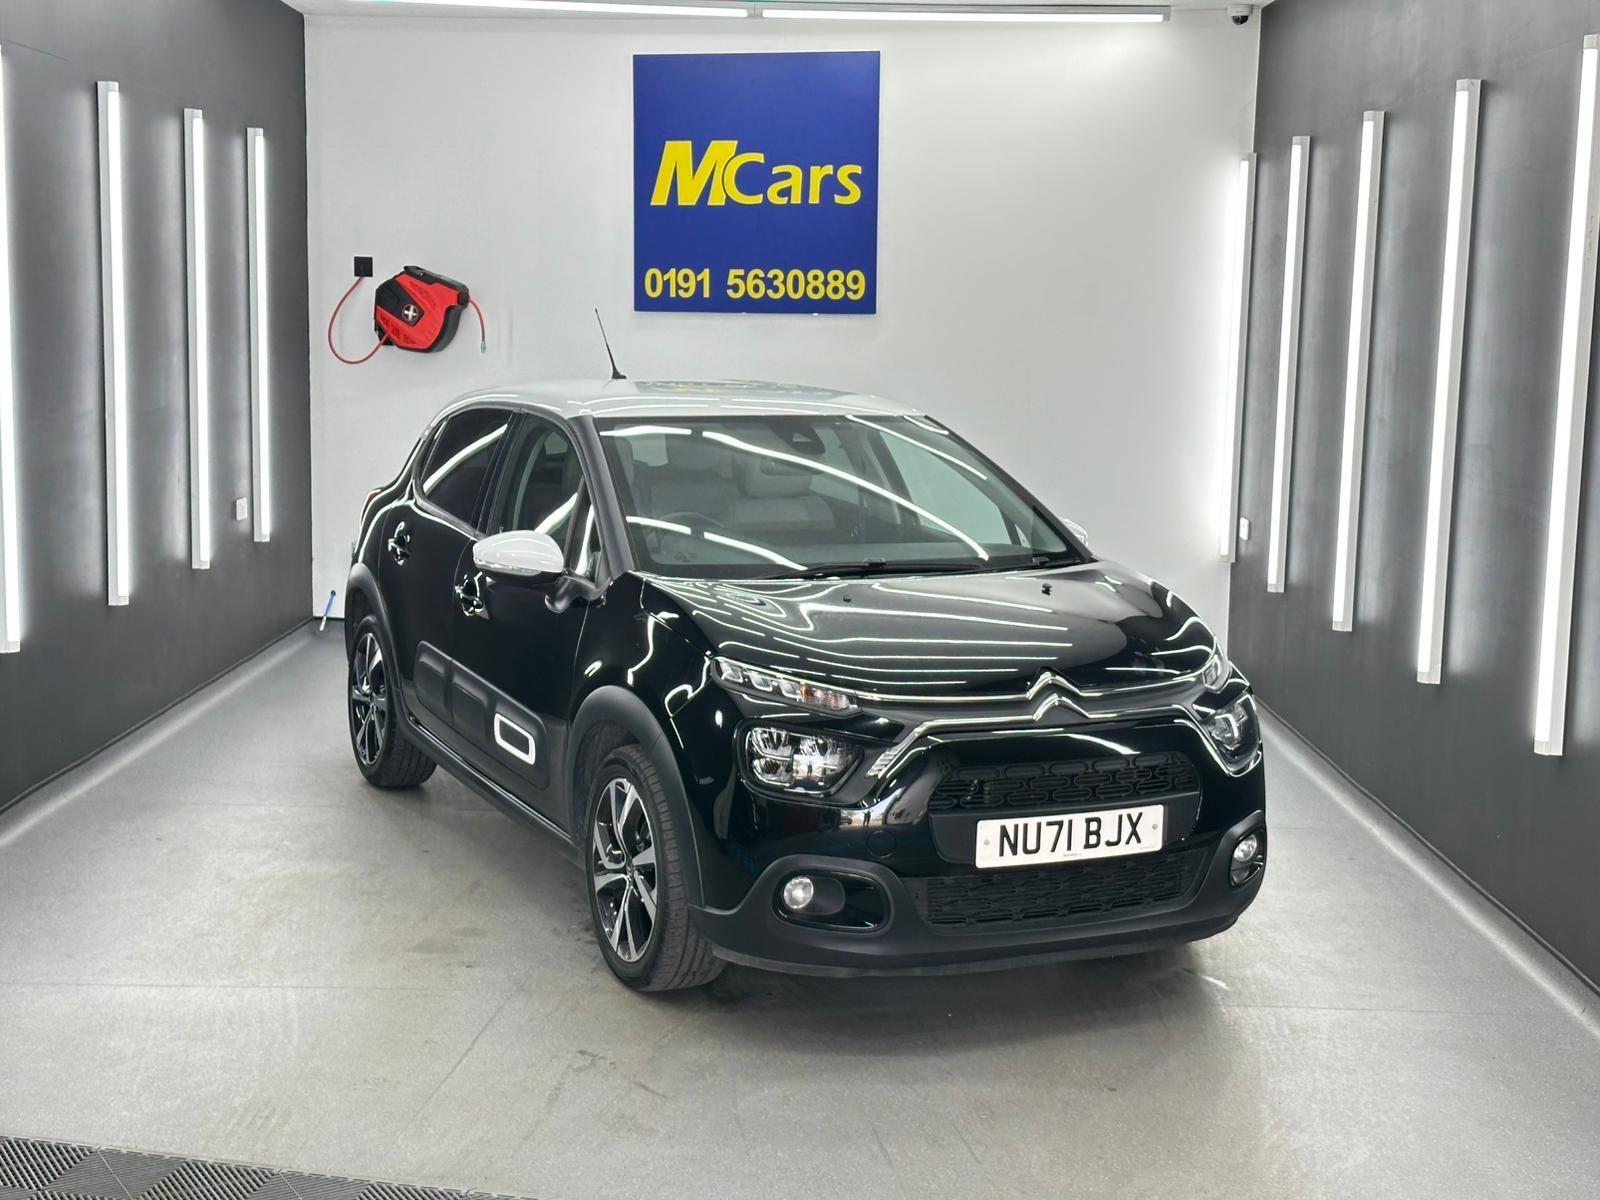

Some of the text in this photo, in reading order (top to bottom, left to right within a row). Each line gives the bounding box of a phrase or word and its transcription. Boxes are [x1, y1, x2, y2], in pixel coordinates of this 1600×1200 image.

[650, 140, 862, 206] MCars
[644, 268, 866, 300] 0191 5630889
[999, 811, 1143, 857] NU71 BJX
